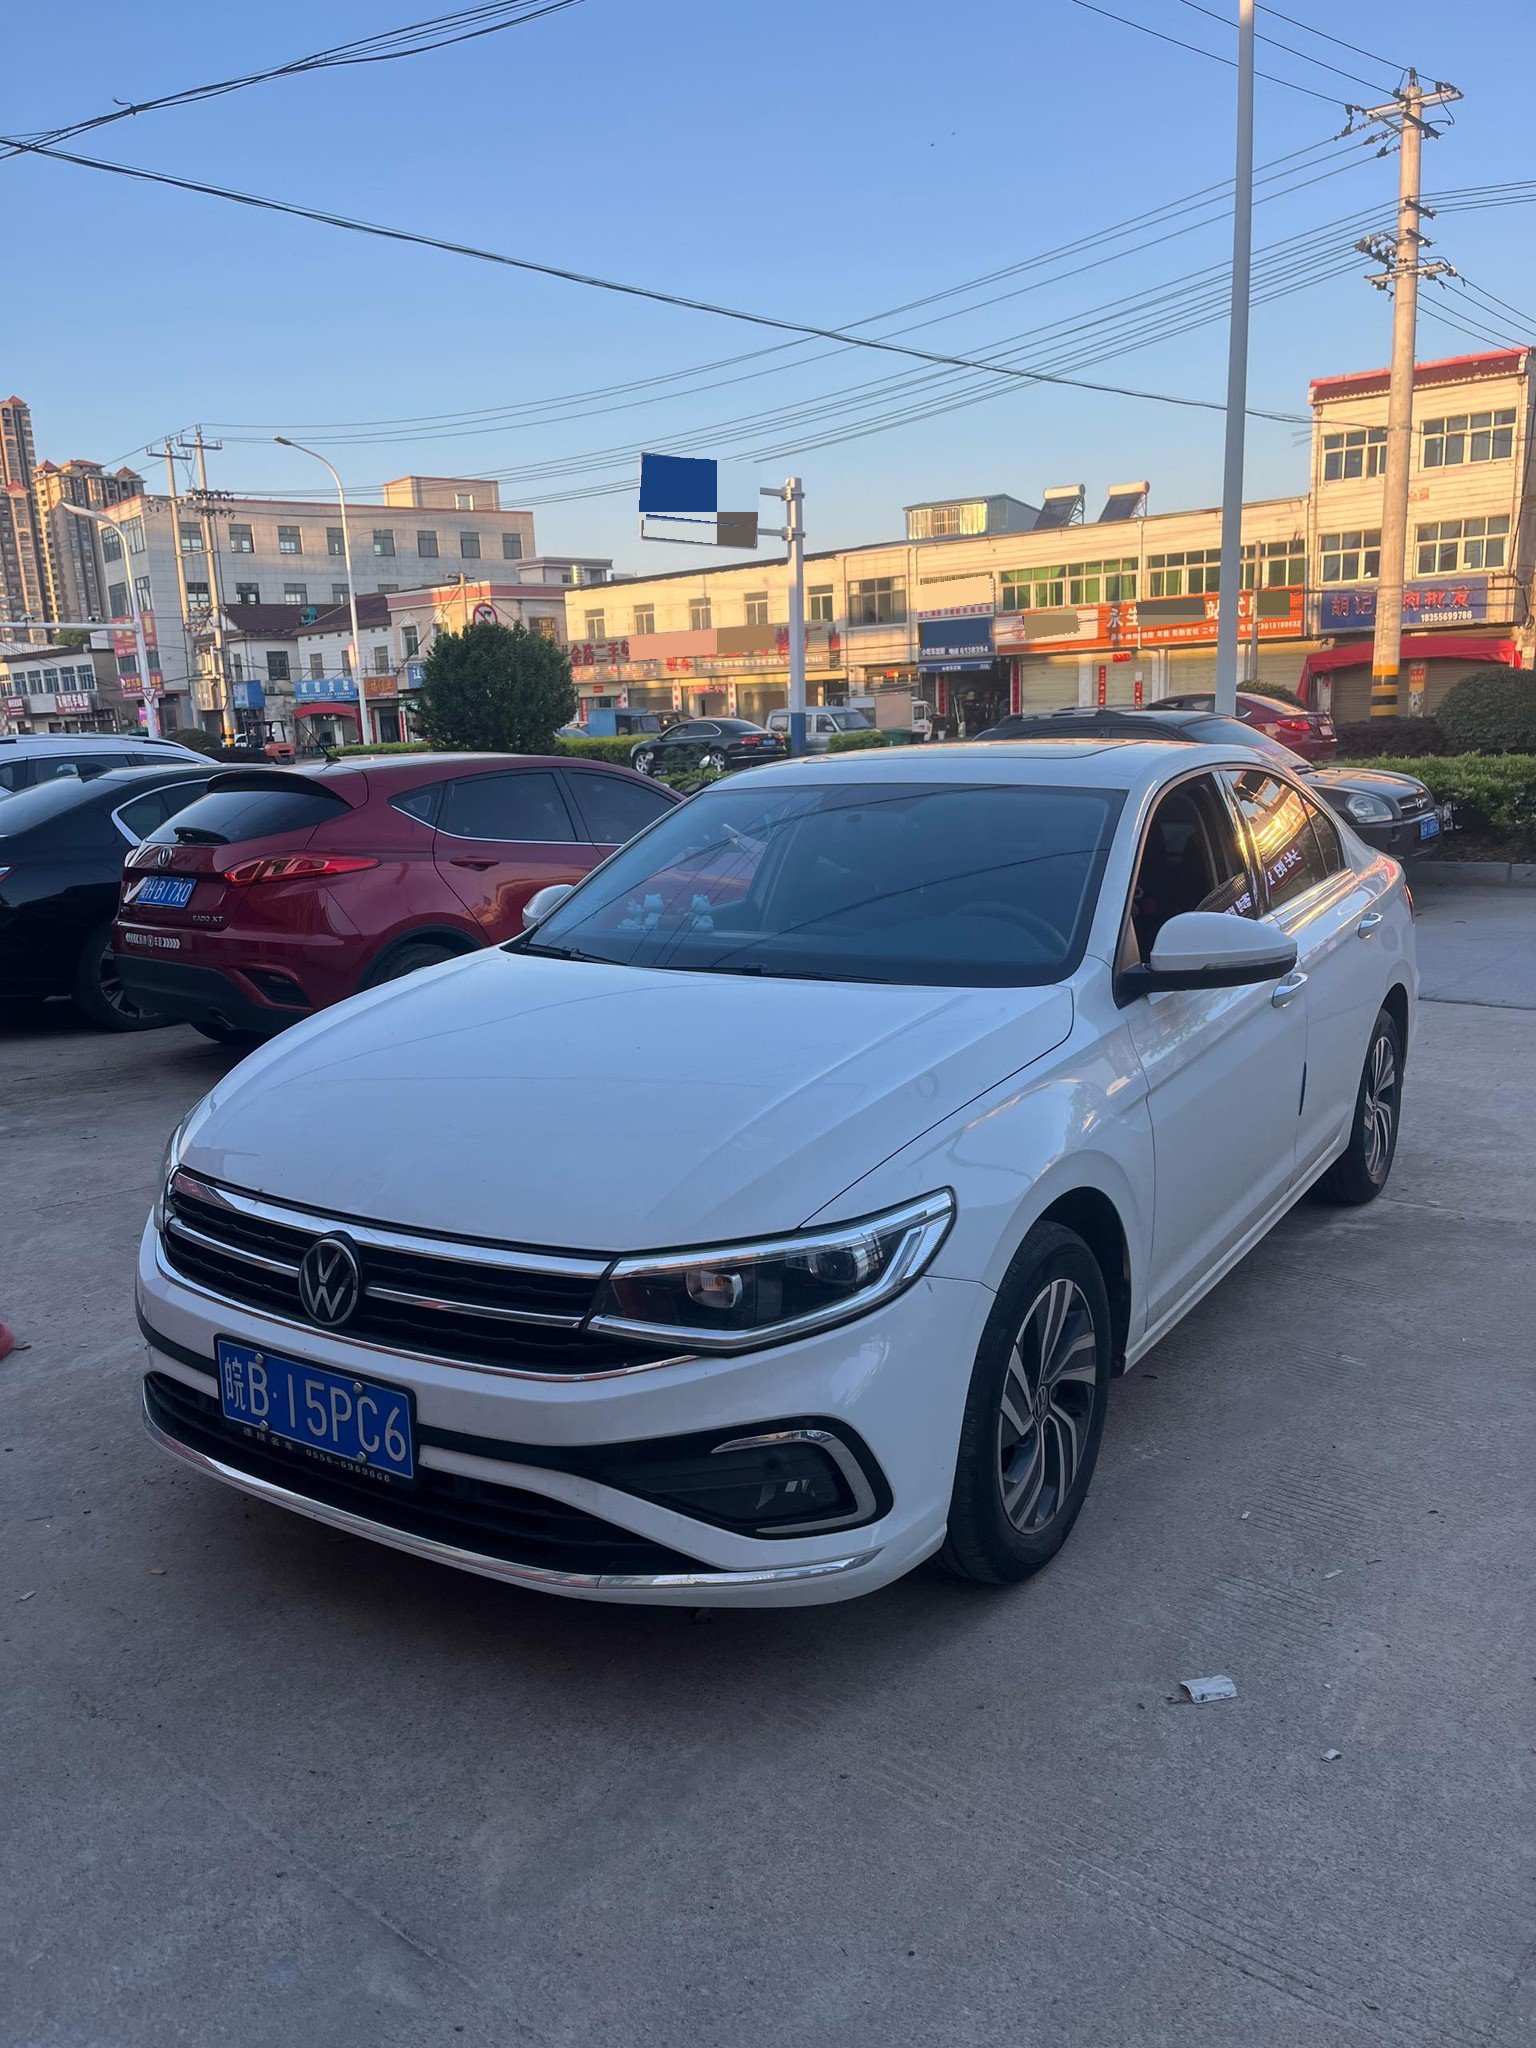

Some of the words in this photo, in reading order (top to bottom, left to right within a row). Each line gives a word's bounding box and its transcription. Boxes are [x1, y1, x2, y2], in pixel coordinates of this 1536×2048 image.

[1332, 585, 1472, 617] 胡记肉批发
